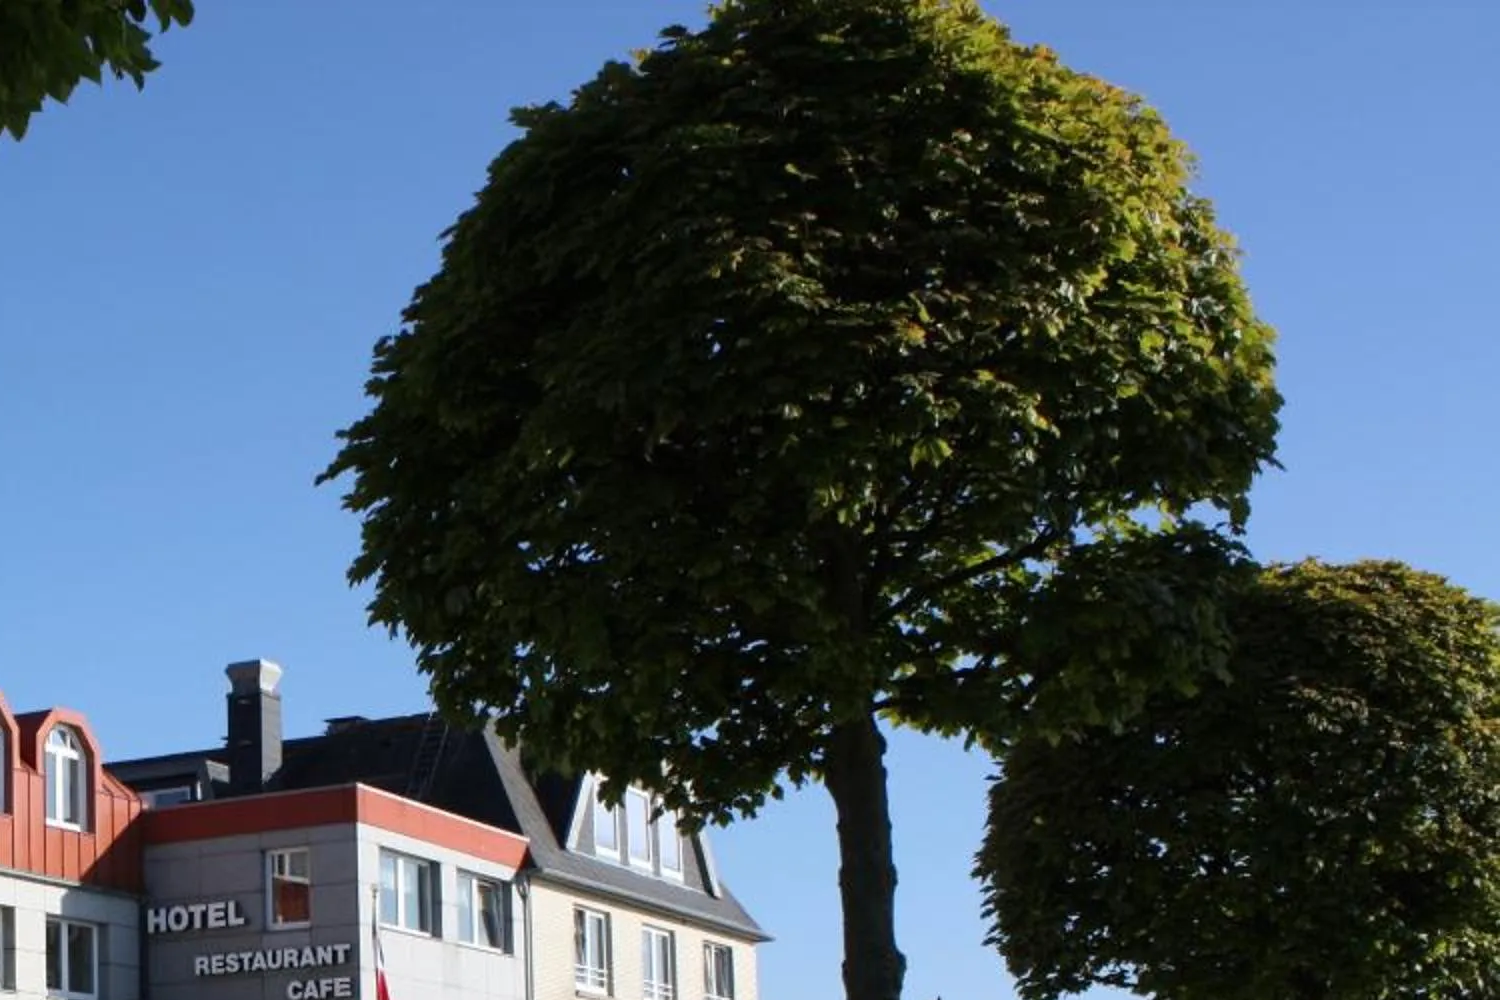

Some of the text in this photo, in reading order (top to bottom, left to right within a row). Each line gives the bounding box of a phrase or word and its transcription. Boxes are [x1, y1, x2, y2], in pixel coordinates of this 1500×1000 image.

[147, 901, 245, 934] HOTEL
[194, 943, 351, 976] RESTAURANT
[287, 977, 352, 1000] CAFE
